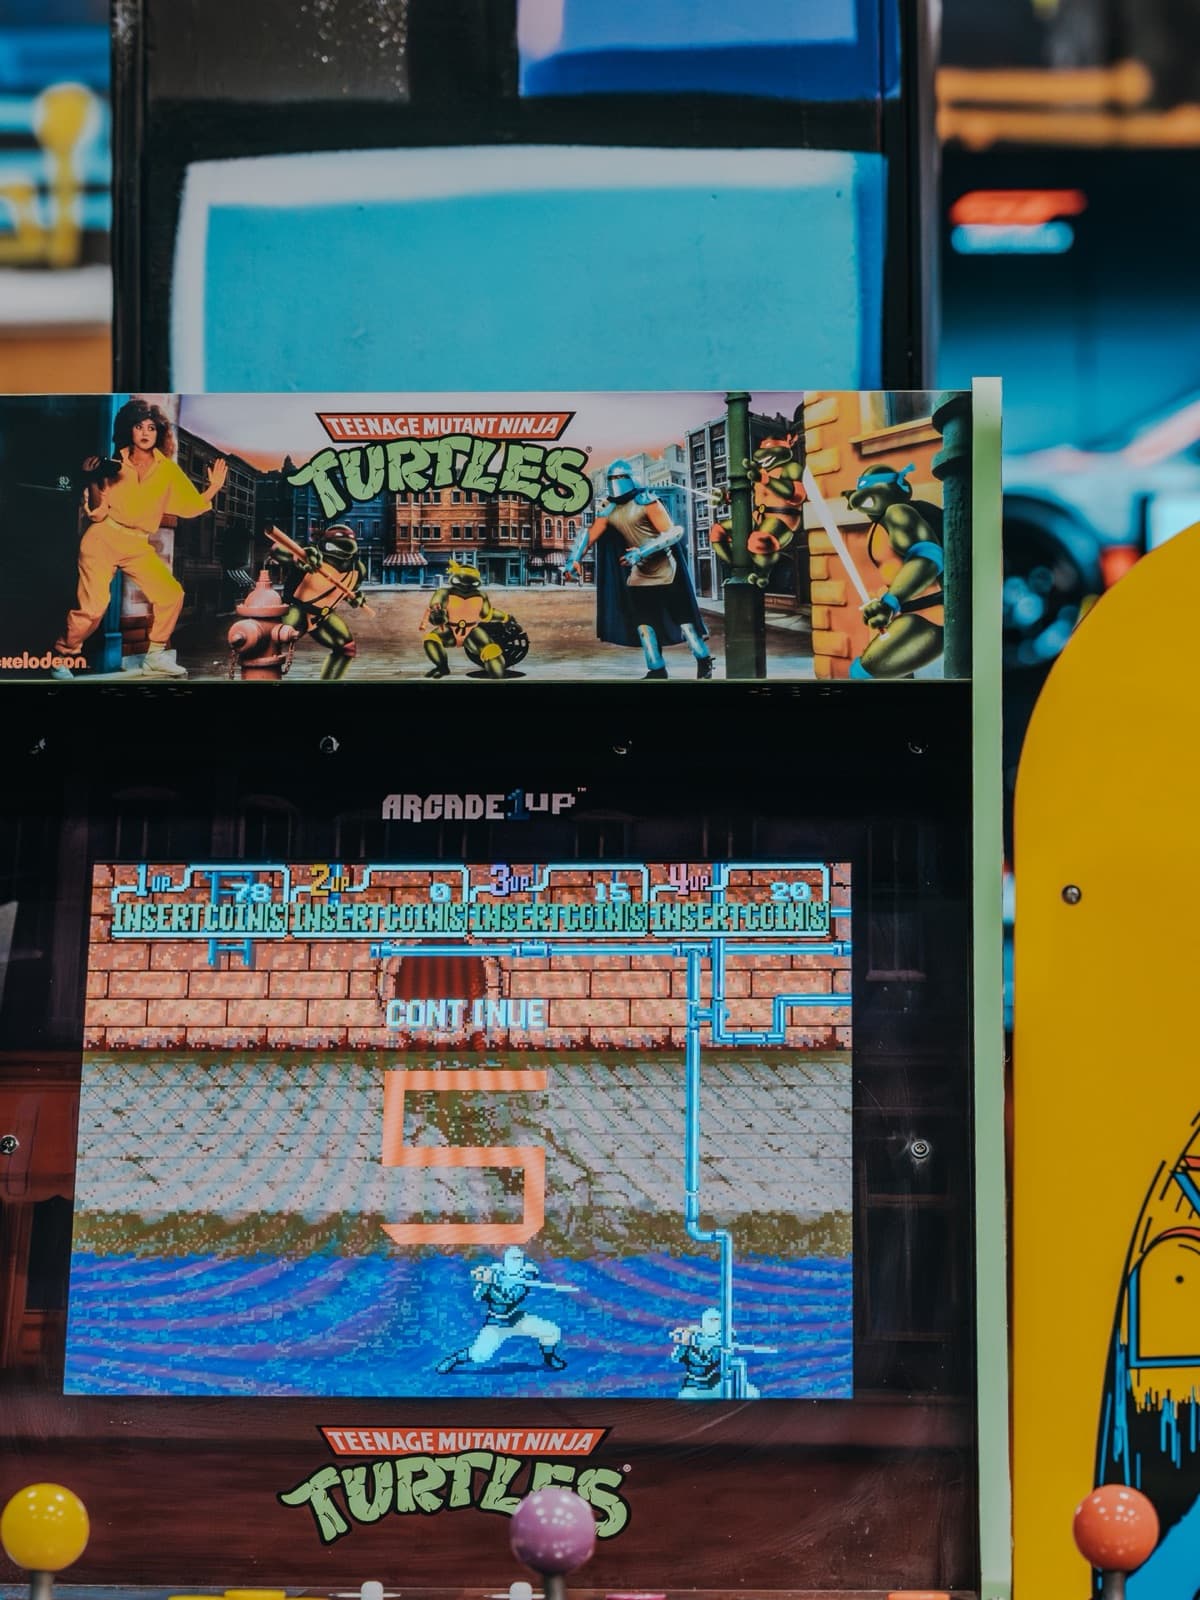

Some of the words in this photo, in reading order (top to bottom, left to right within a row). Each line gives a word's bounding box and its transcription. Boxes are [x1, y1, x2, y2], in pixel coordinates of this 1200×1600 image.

[325, 417, 420, 436] TEENAGE
[423, 417, 497, 436] MUTANT
[498, 417, 560, 435] NINJA
[286, 434, 592, 520] TURTLES
[0, 651, 87, 670] kelodeon
[386, 999, 548, 1031] CONTINUE
[380, 1070, 547, 1244] 5
[327, 1431, 433, 1451] TEENAGE
[437, 1431, 520, 1452] MUTANT
[524, 1432, 595, 1452] NINJA
